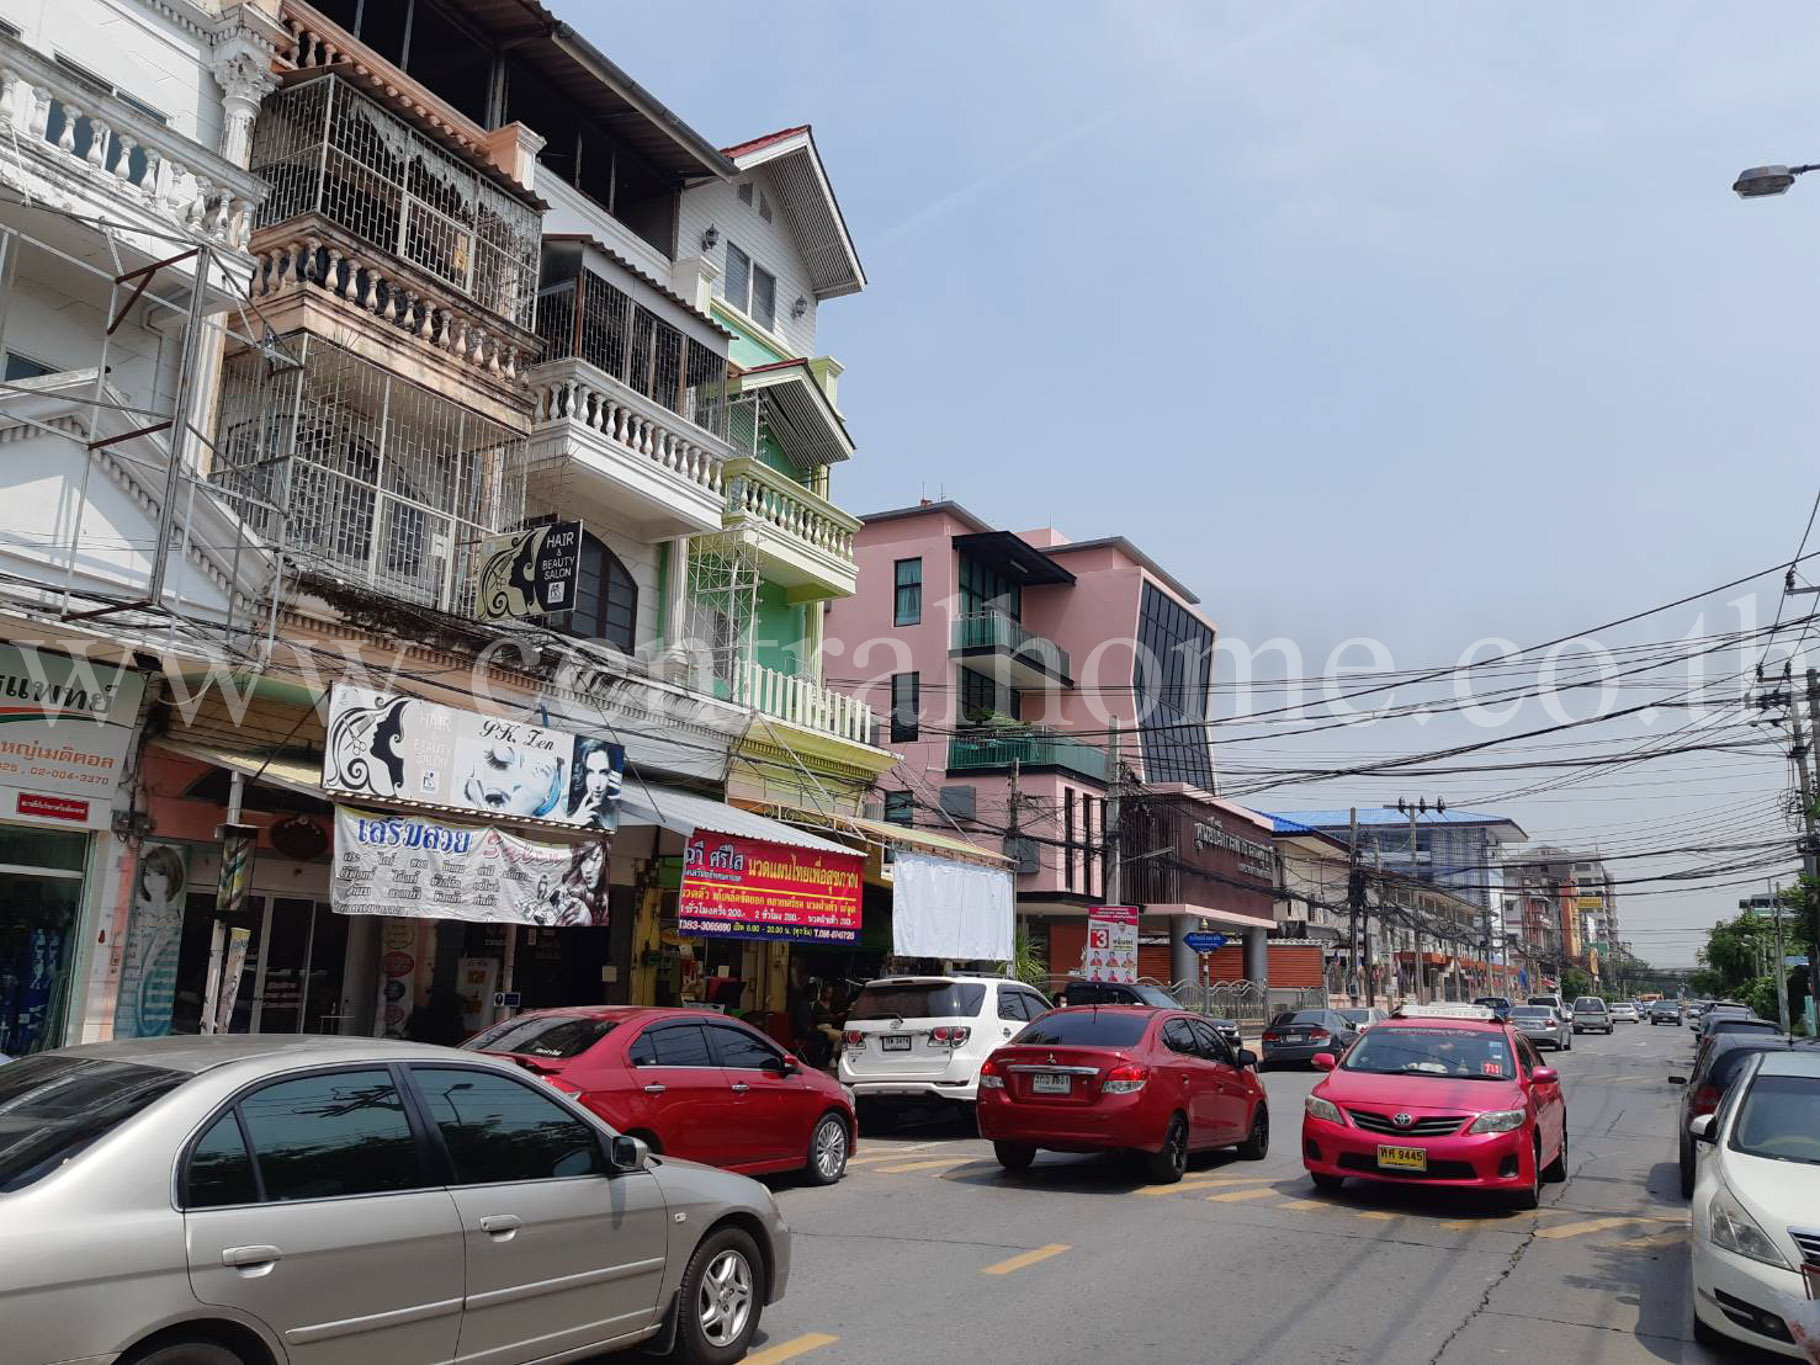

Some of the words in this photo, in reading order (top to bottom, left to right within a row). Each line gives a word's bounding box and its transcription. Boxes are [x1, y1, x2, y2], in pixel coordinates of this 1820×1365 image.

[546, 532, 574, 549] HAIR
[542, 556, 575, 571] BEAUTY
[544, 568, 572, 580] SALON
[357, 816, 472, 854] เสริมสวย
[748, 852, 860, 896] นวดแผนไทยเพื่อสุขภาพ
[1096, 930, 1107, 947] 3
[1399, 1150, 1422, 1161] 9445
